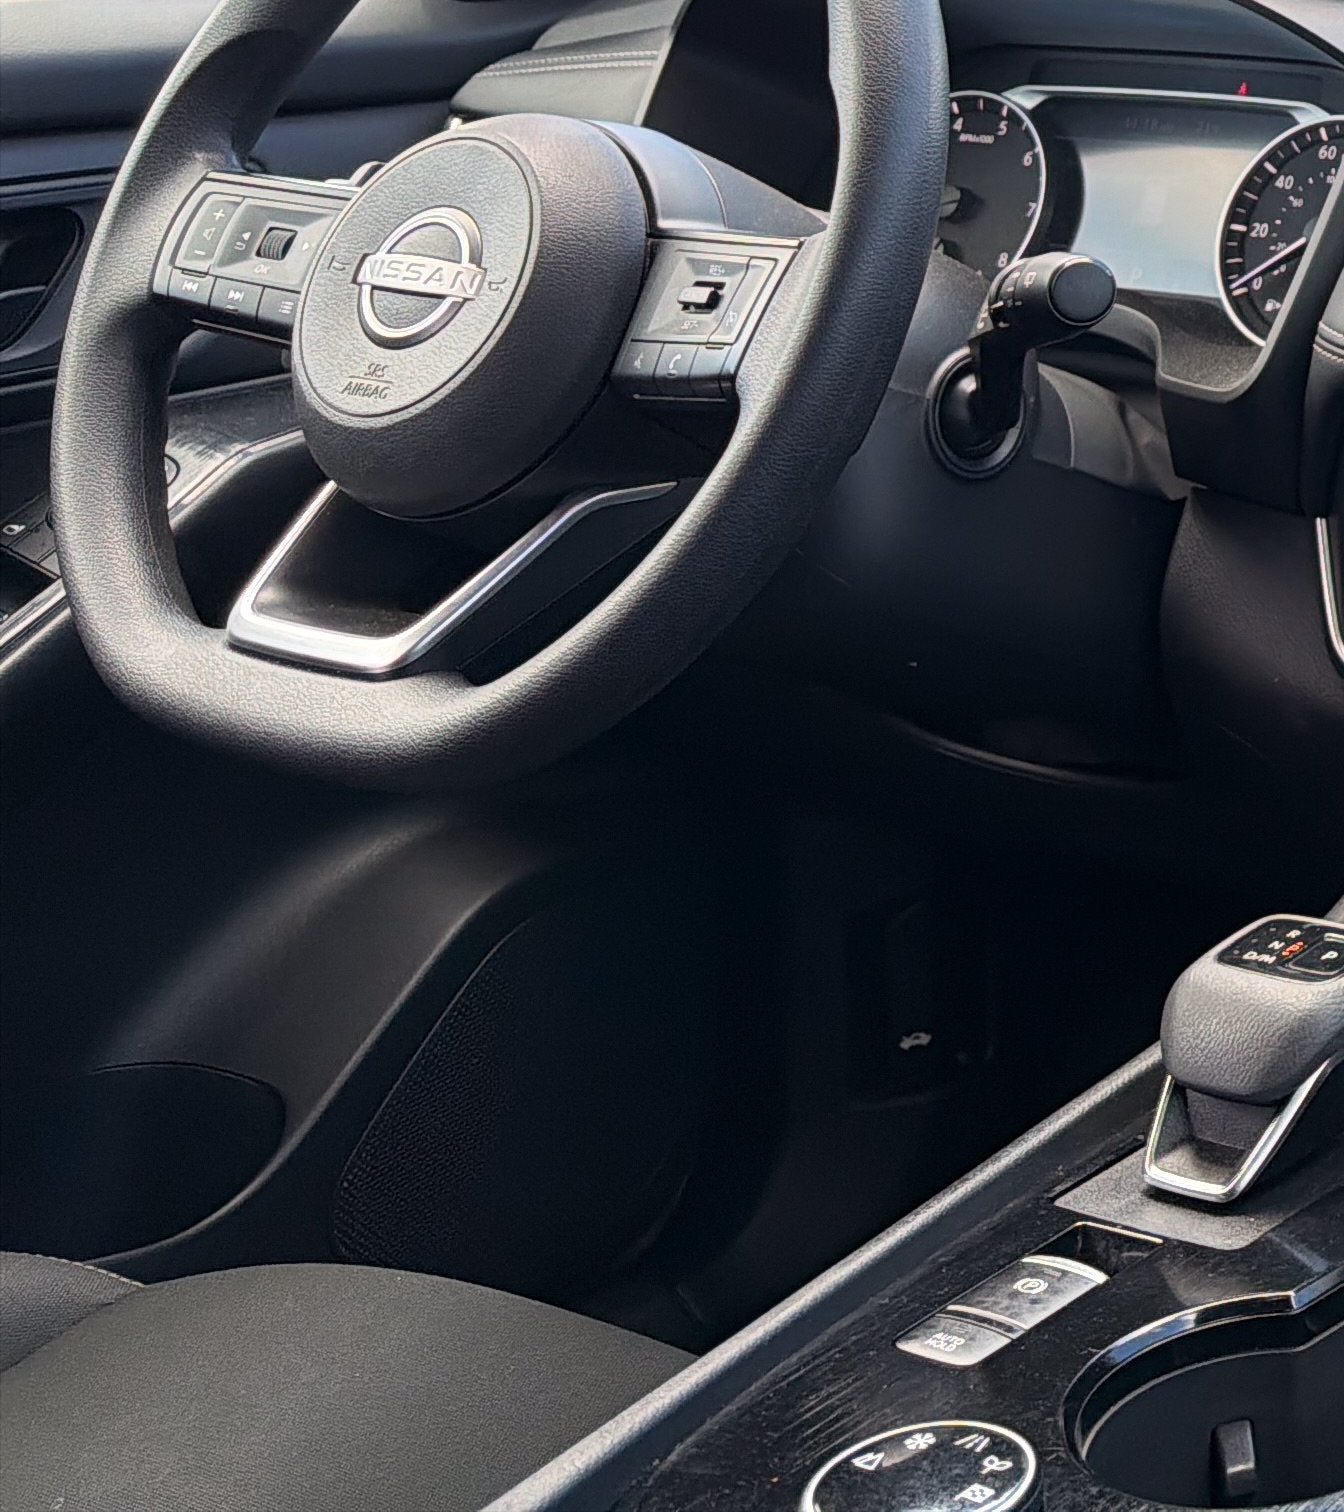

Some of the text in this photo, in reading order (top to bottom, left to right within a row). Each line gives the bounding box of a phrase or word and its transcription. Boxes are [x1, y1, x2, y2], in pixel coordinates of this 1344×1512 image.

[953, 117, 963, 132] 4
[998, 121, 1008, 136] 5
[1023, 151, 1033, 167] 6
[1318, 145, 1337, 160] 60
[1275, 175, 1294, 189] 40
[1026, 202, 1037, 217] 7
[1250, 223, 1269, 237] 20
[998, 252, 1009, 268] 8
[361, 257, 482, 296] NISSAN
[1252, 276, 1263, 290] 0
[364, 362, 389, 378] SRS
[341, 381, 390, 400] AIRBAG
[1285, 929, 1300, 939] R
[1268, 941, 1283, 951] N
[1242, 950, 1277, 964] D/M
[1320, 951, 1339, 961] P
[925, 1337, 957, 1352] HOLD
[933, 1332, 966, 1346] AUTO
